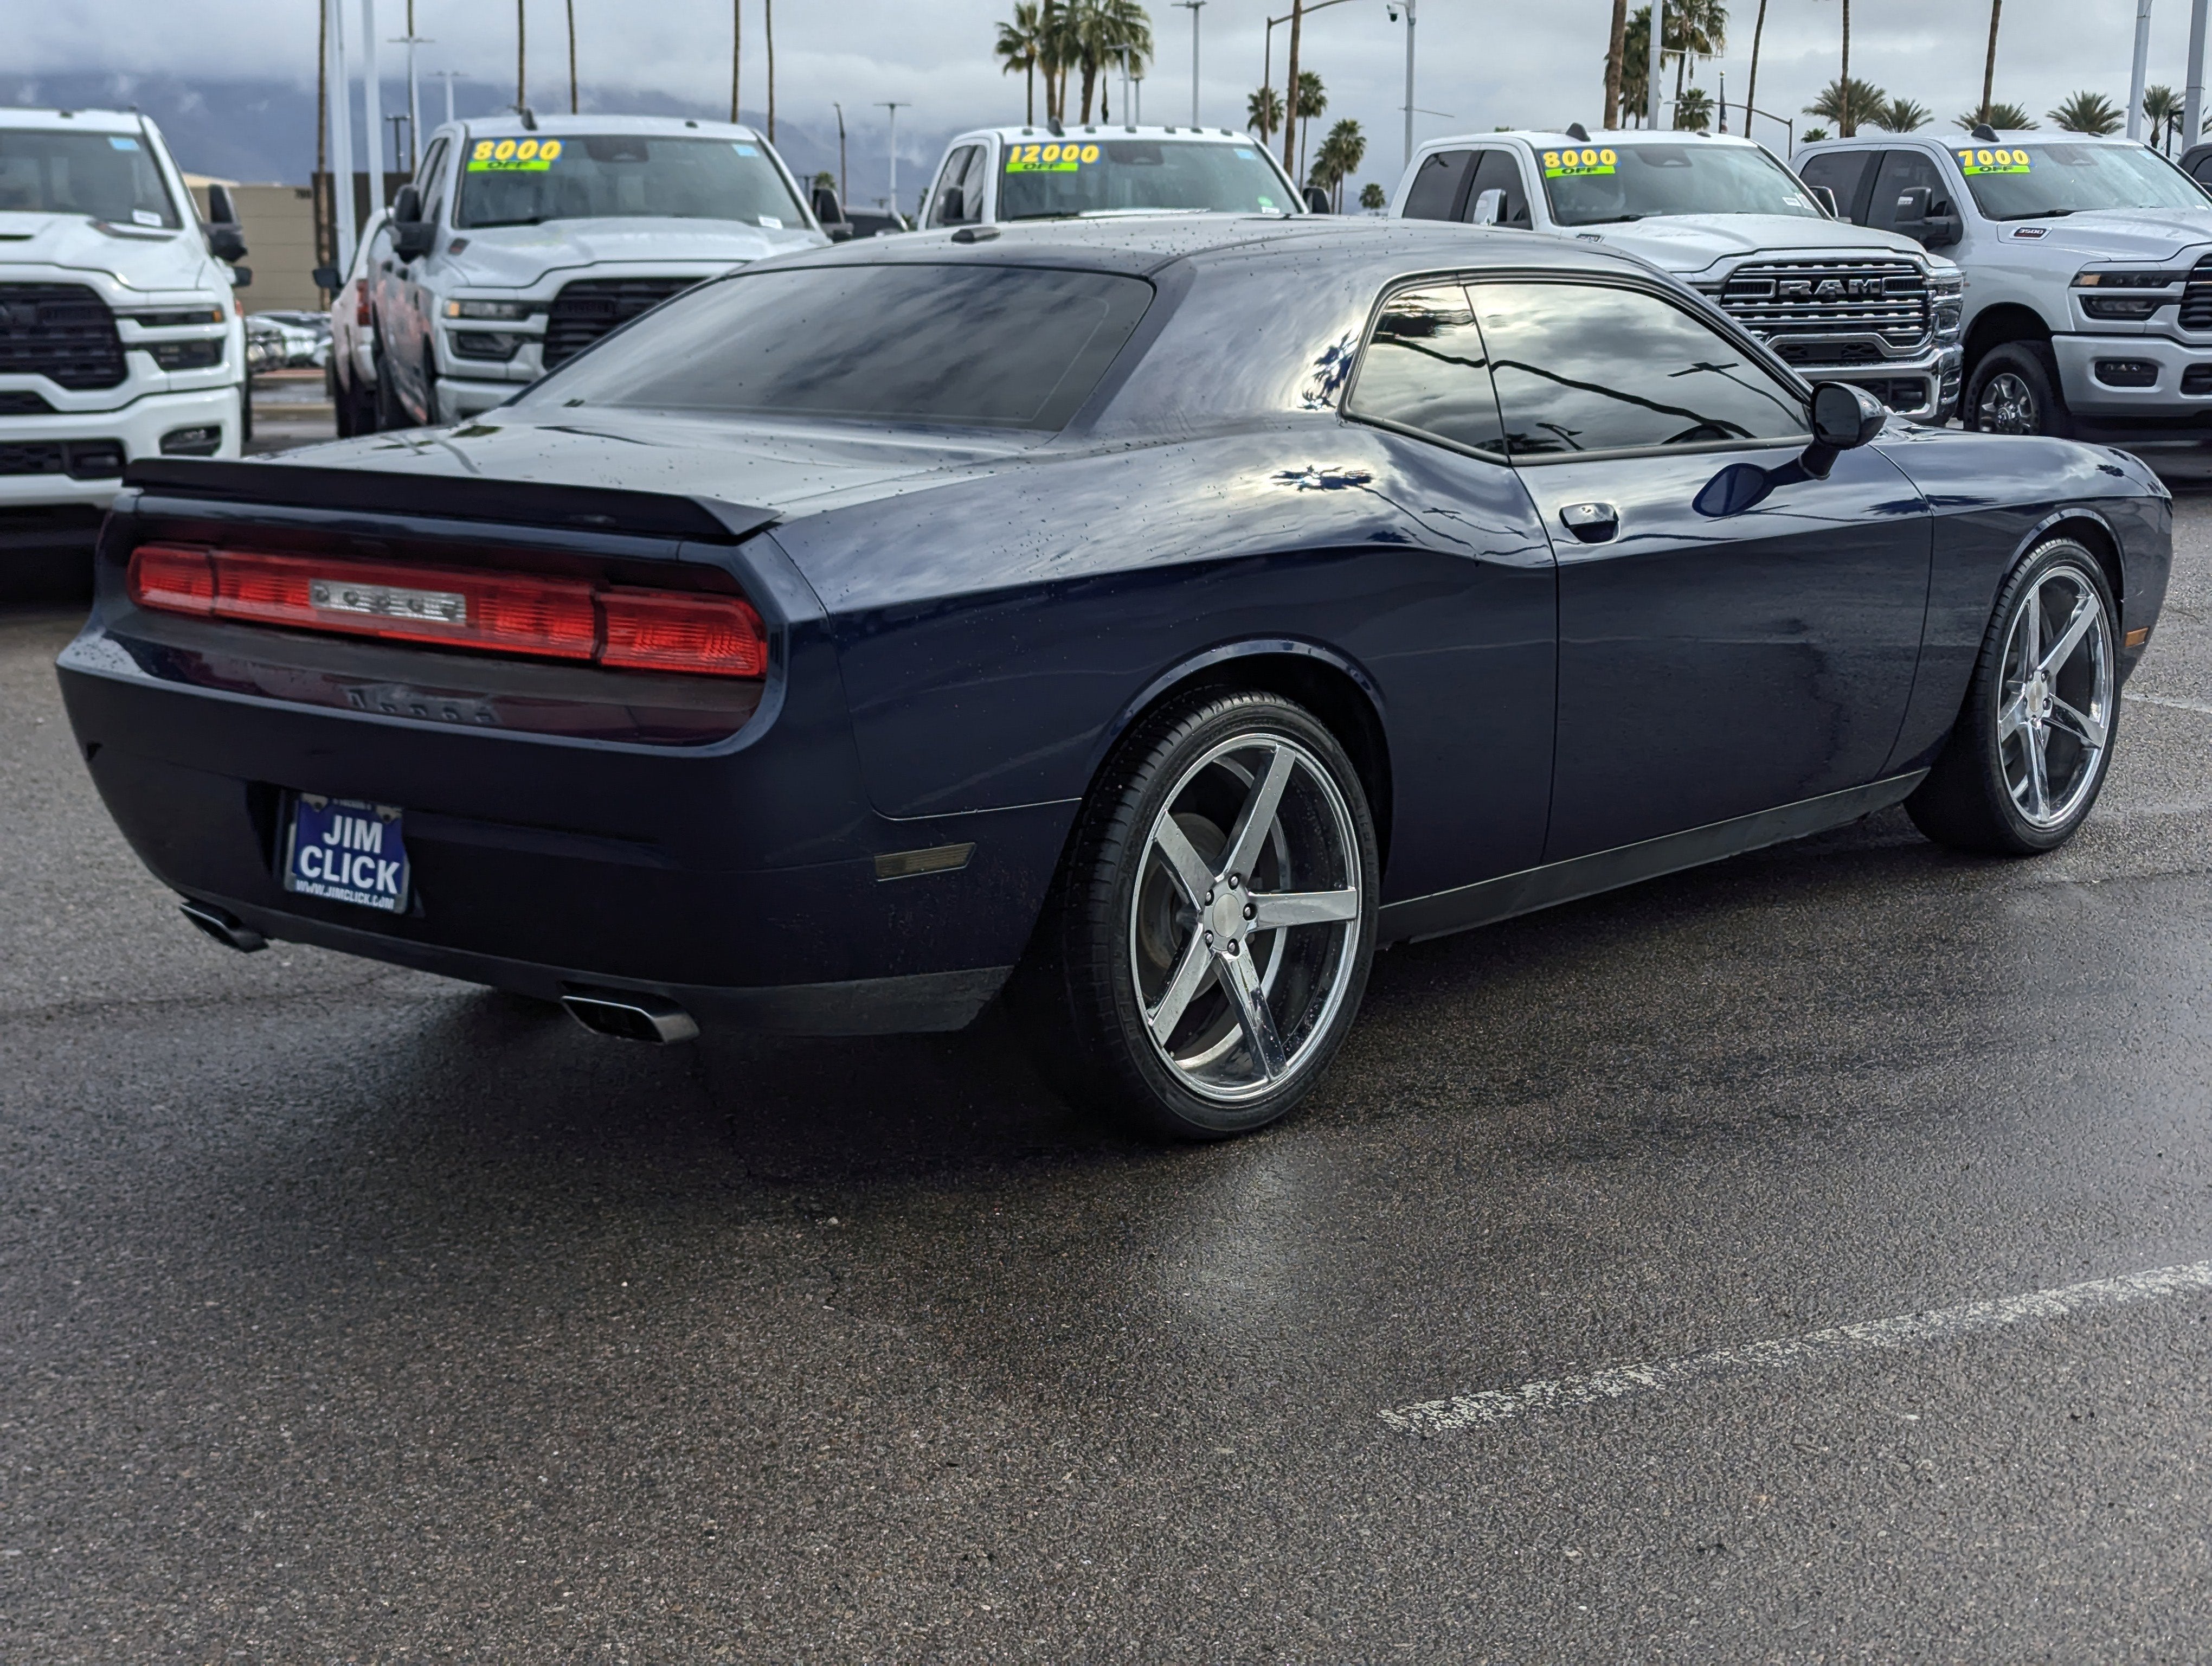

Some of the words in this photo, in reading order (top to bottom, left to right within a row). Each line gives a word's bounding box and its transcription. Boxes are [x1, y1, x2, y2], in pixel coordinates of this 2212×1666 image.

[473, 139, 561, 161] 8000
[1009, 144, 1099, 163] 12000
[1543, 149, 1617, 168] 8000
[1958, 150, 2030, 166] 7000
[1779, 278, 1881, 295] RAM
[323, 815, 383, 854] JIM
[300, 845, 401, 894] CLICK
